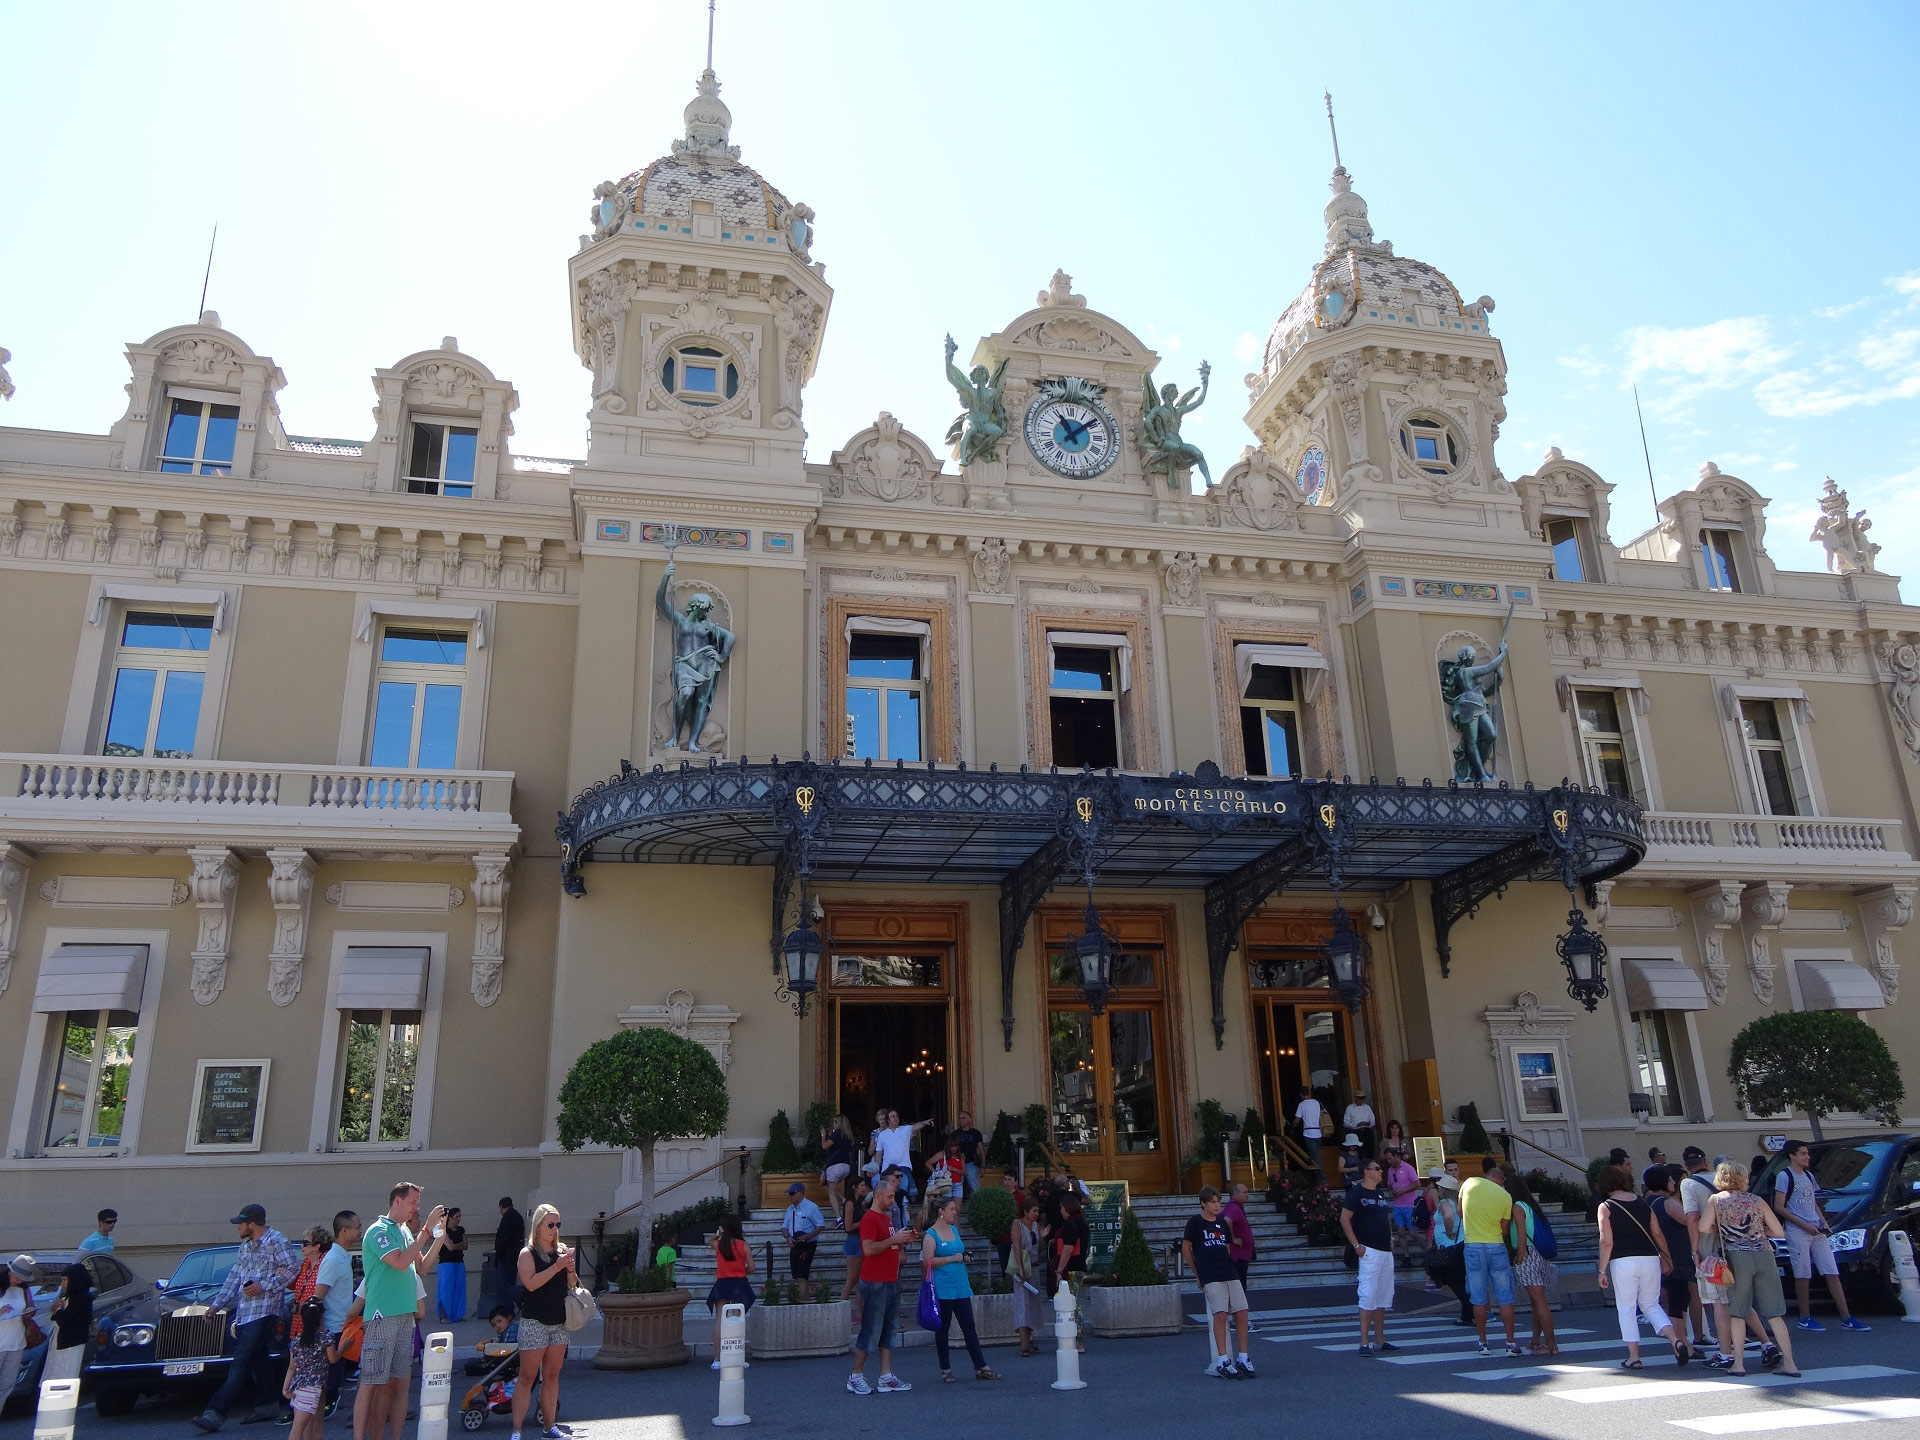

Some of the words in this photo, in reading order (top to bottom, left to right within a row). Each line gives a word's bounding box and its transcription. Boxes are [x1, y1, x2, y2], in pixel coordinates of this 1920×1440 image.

[1175, 788, 1246, 802] CASINO
[1134, 797, 1288, 815] MONTE-CARLO
[175, 1364, 198, 1374] X925
